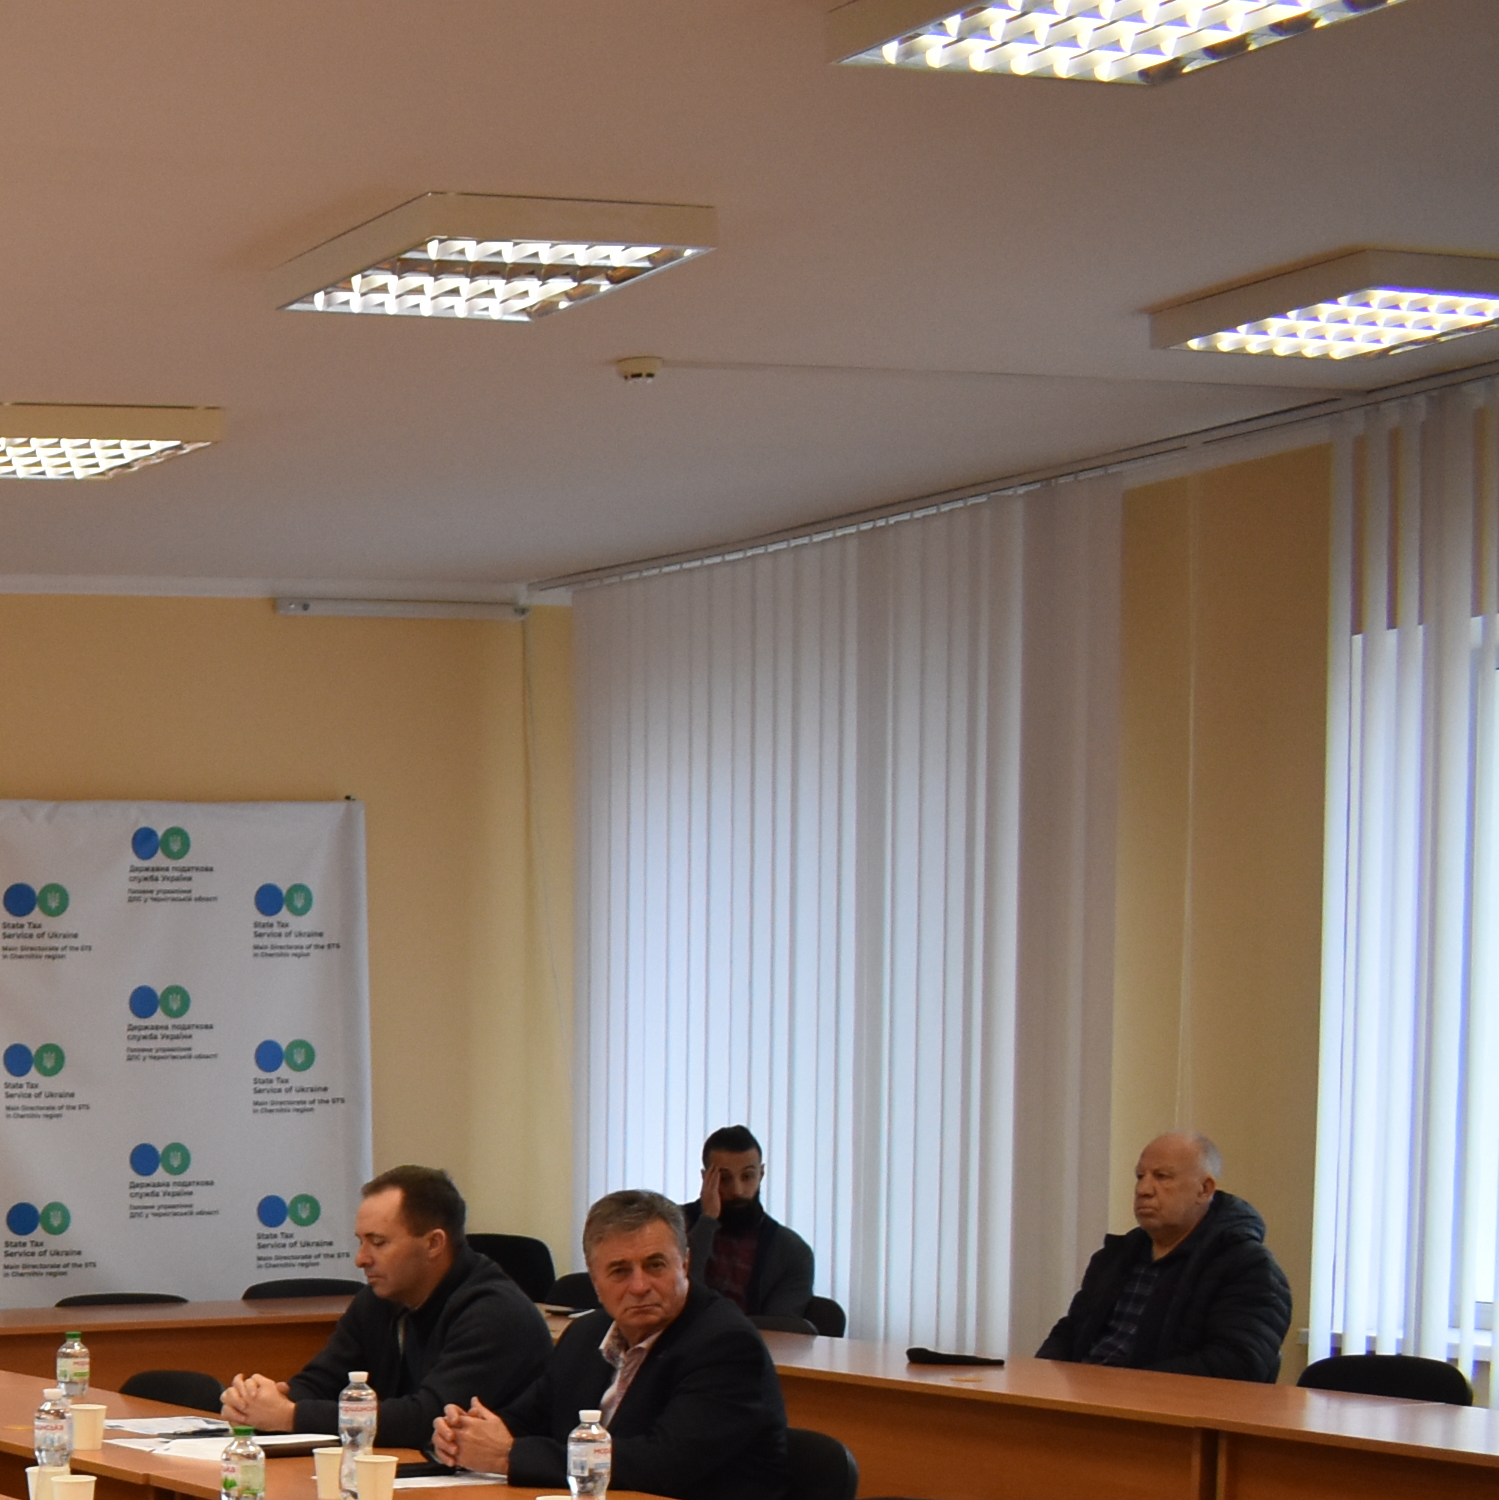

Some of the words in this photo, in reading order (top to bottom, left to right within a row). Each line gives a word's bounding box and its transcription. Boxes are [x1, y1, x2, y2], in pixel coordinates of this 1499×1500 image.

[2, 921, 25, 929] State
[27, 921, 42, 929] Tax
[253, 921, 274, 929] State
[284, 930, 293, 938] of
[253, 1077, 273, 1085] State
[275, 1076, 289, 1084] Tax
[4, 1081, 24, 1089] State
[26, 1081, 39, 1089] Tax
[4, 1091, 32, 1099] Service
[34, 1091, 43, 1099] of
[256, 1232, 278, 1240] State
[280, 1231, 294, 1239] Tax
[4, 1240, 27, 1248] State
[300, 1240, 334, 1248] Ukraine
[38, 1249, 48, 1257] of
